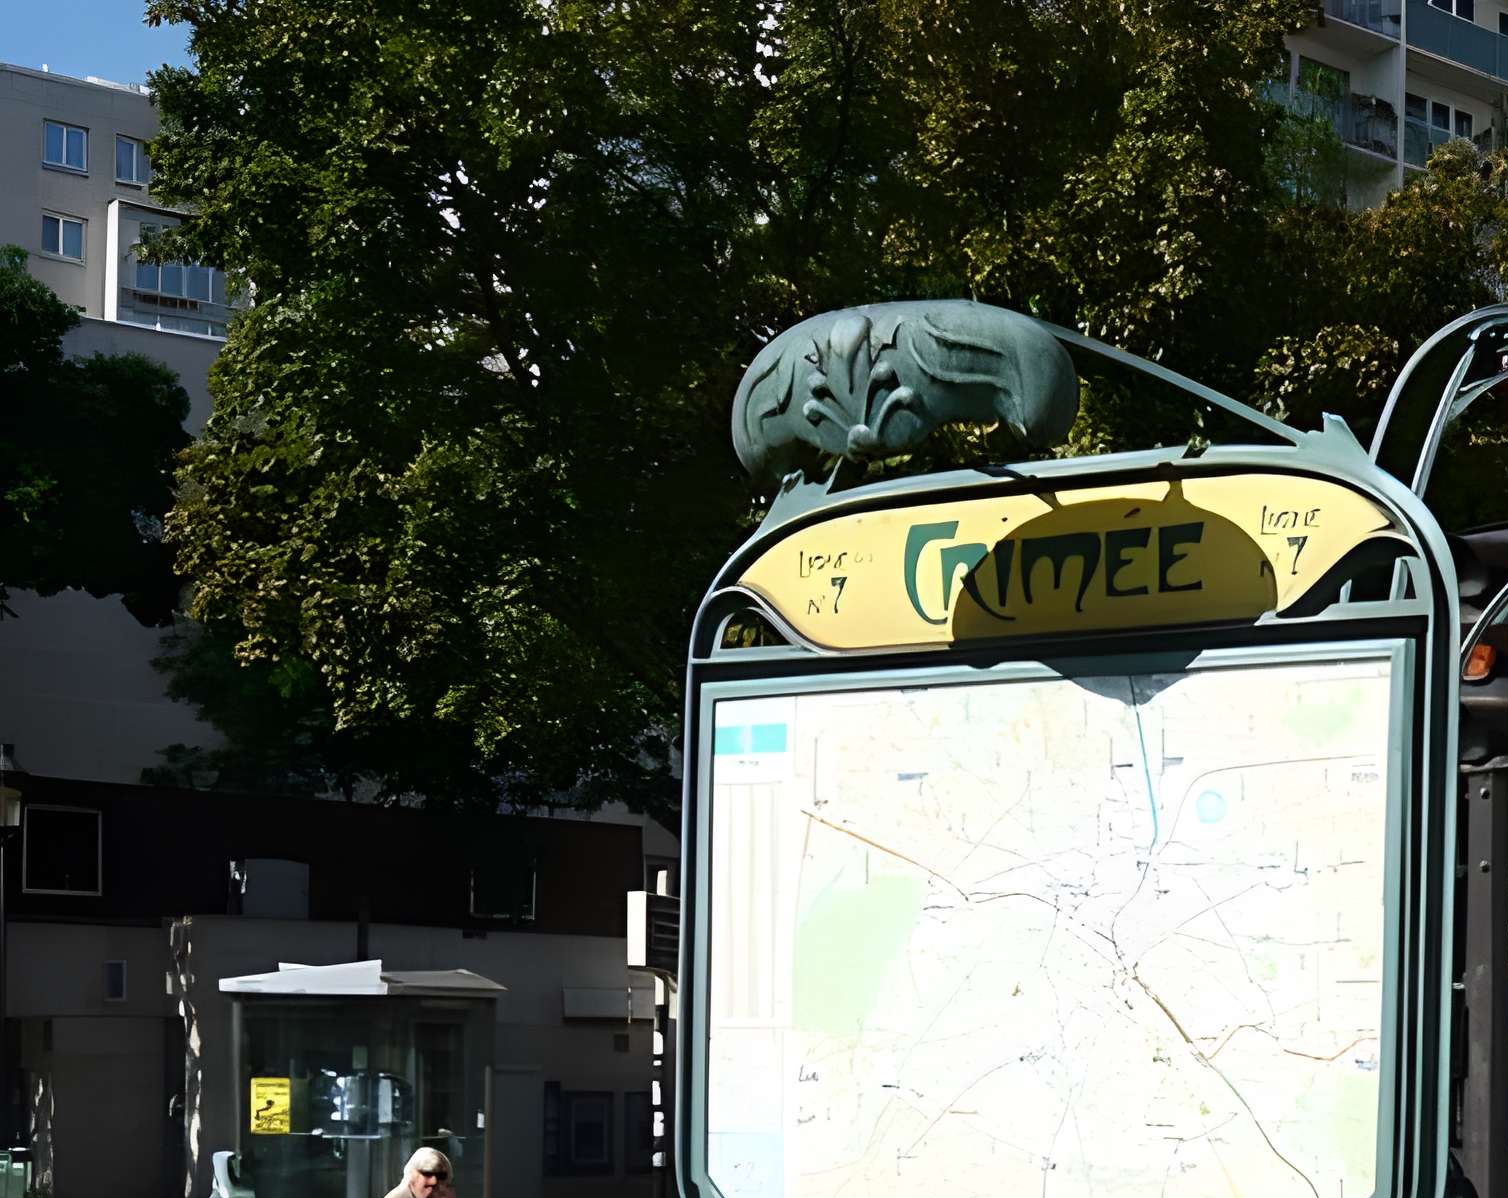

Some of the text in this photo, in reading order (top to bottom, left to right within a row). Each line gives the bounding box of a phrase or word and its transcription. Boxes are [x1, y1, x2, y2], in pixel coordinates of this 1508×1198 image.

[903, 507, 1204, 625] CRIMÉE
[1286, 535, 1309, 575] 7
[830, 576, 848, 614] 7
